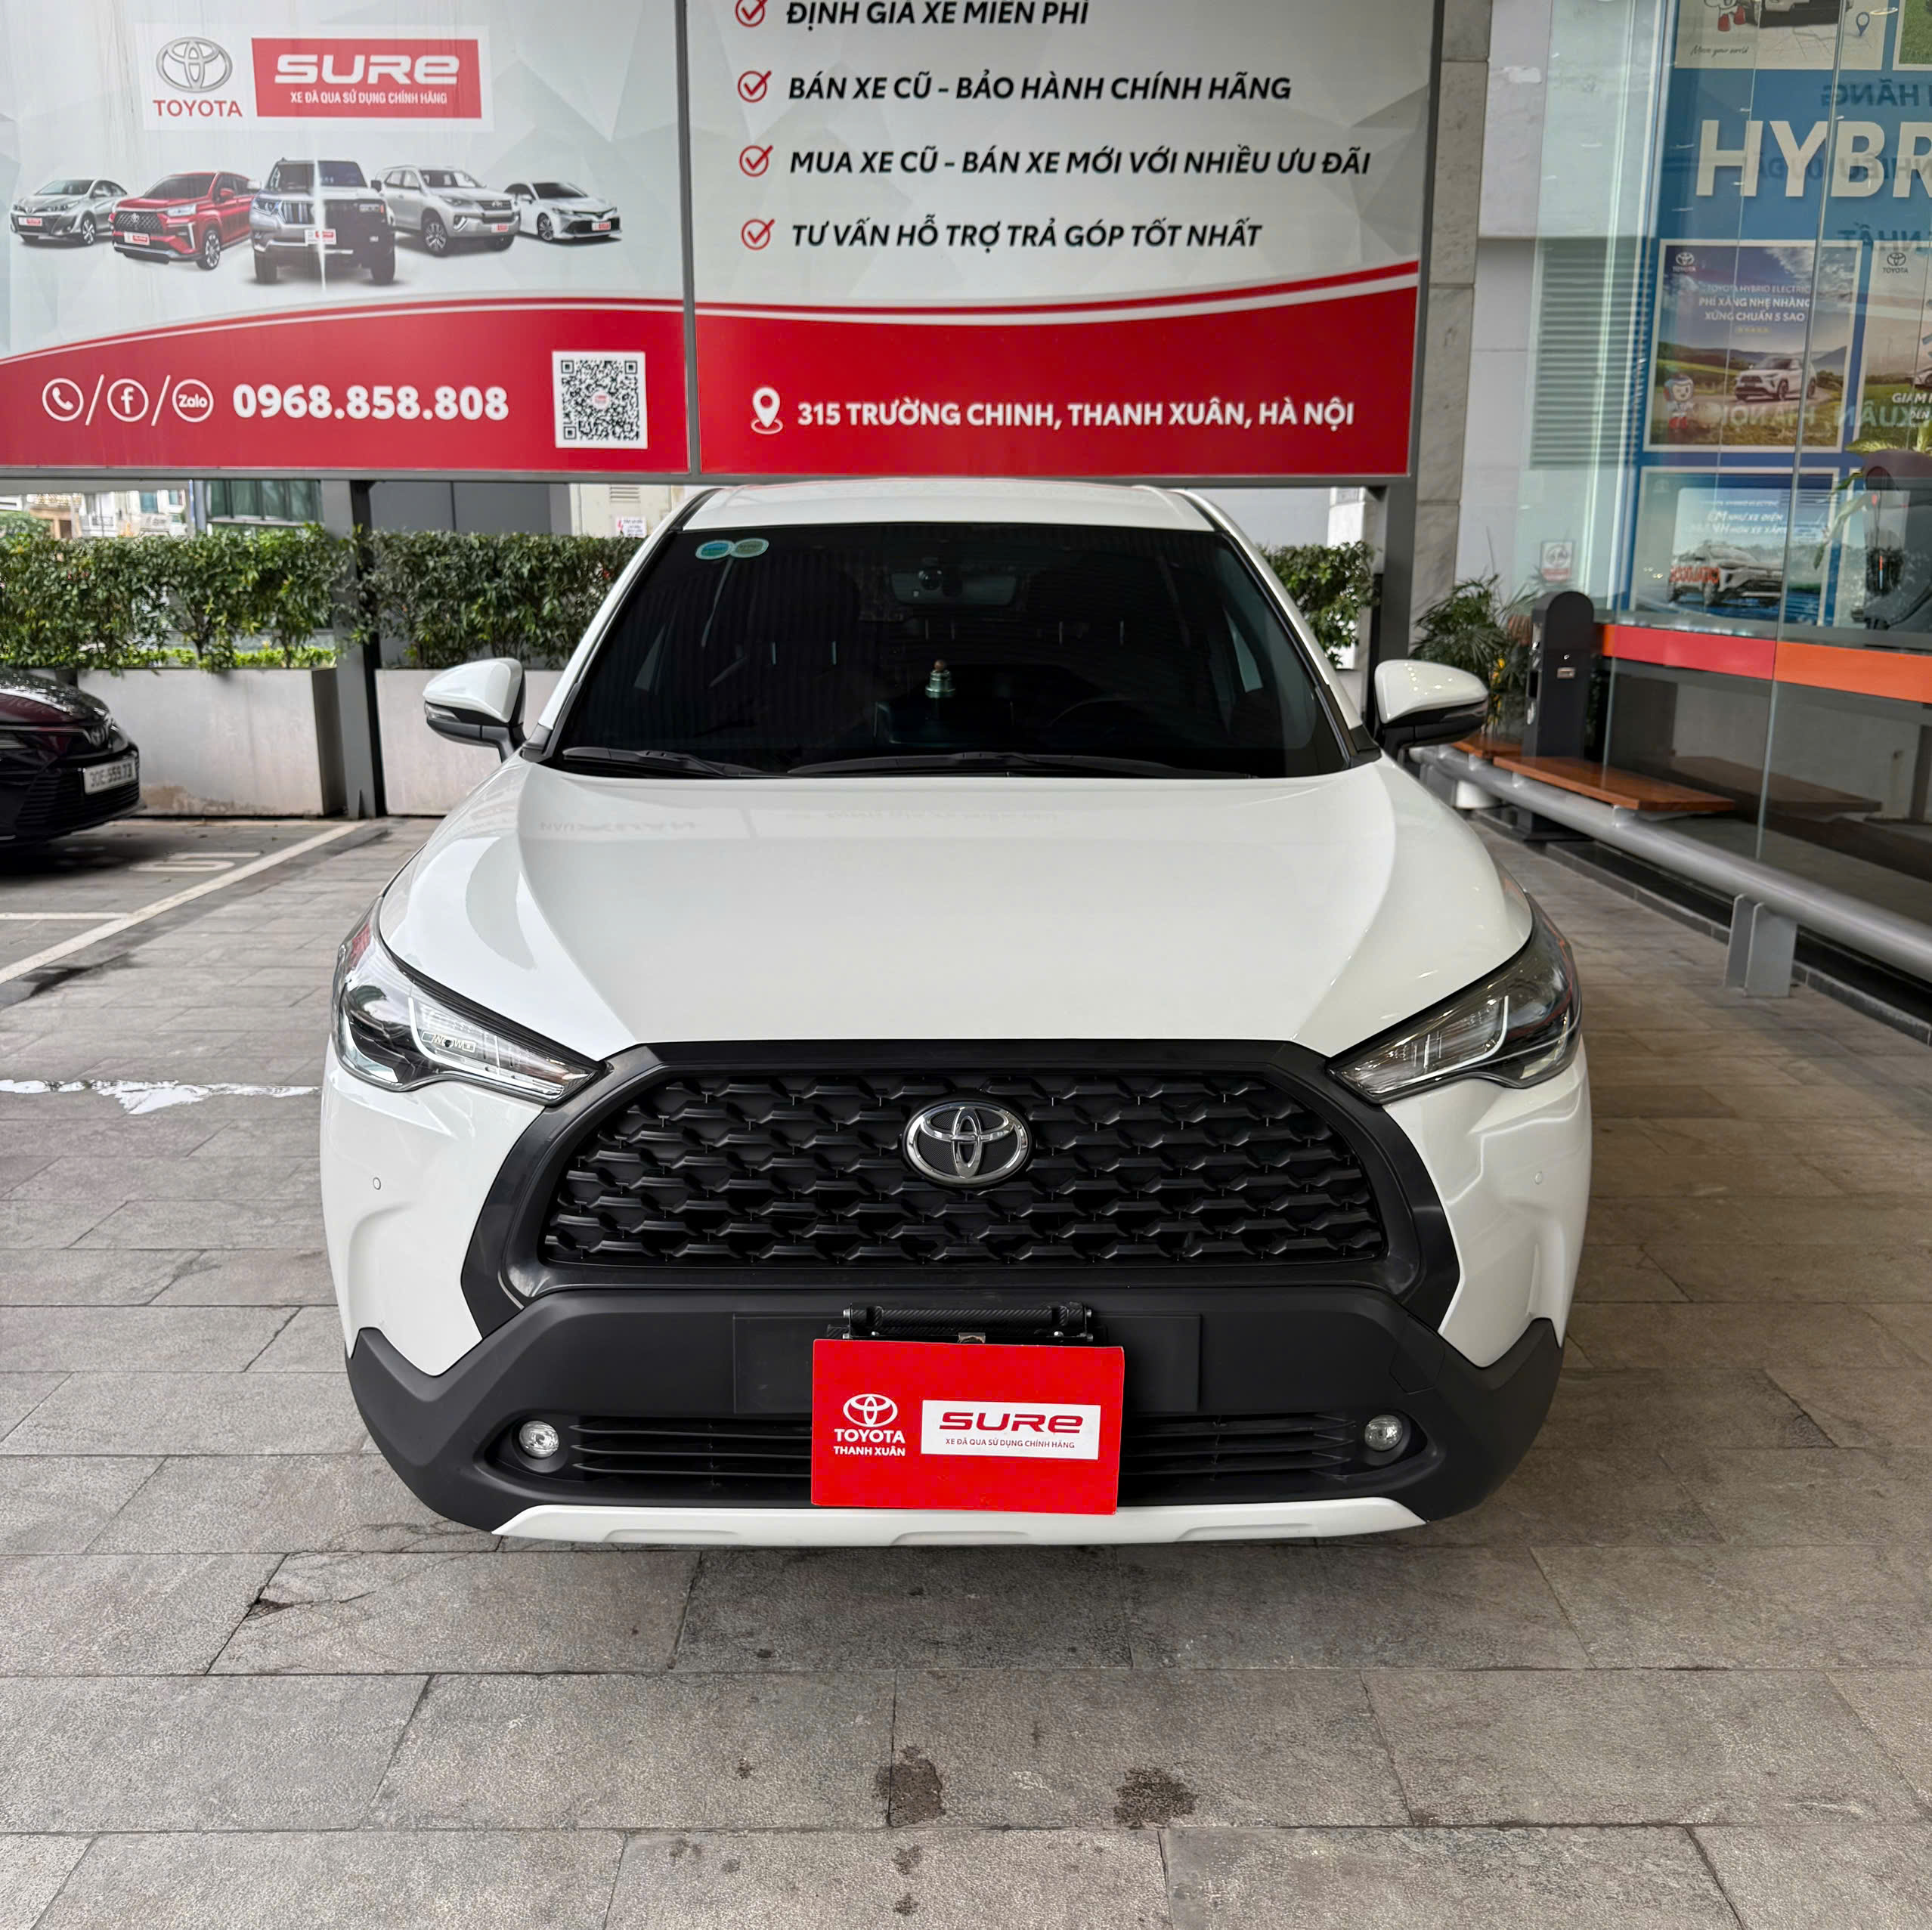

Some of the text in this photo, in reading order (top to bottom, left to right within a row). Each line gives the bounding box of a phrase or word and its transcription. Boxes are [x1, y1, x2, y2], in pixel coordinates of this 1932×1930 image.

[786, 2, 859, 31] ĐỊNH
[922, 2, 957, 24] XE
[788, 71, 847, 99] BÁN
[853, 77, 887, 99] XE
[893, 72, 932, 99] CŨ
[956, 70, 1014, 99] BẢO
[1020, 72, 1104, 100] HÀNH
[1111, 72, 1201, 100] CHÍNH
[1208, 73, 1292, 100] HÃNG
[290, 91, 302, 103] XE
[320, 91, 341, 104] QUA
[358, 91, 386, 105] DỤNG
[153, 100, 242, 117] TOYOTA
[790, 152, 853, 173] MUA
[859, 152, 894, 173] XE
[900, 146, 938, 174] CŨ
[961, 145, 1020, 174] BÁN
[1026, 152, 1060, 173] XE
[1066, 146, 1122, 174] MỚI
[1129, 146, 1178, 174] VỚI
[1184, 144, 1270, 174] NHIỀU
[1277, 149, 1316, 174] ƯU
[1322, 147, 1370, 174] ĐÃI
[792, 214, 1262, 253] TƯ VẤN HỖ TRỢ TRẢ GÓP TỐT NHẤT
[1740, 285, 1770, 293] HYBRID
[1772, 285, 1811, 294] ELECTRIC
[1783, 312, 1806, 322] SAO
[178, 392, 208, 409] Zalo
[232, 383, 509, 420] 0968.858.808
[797, 396, 1355, 432] 315 TRƯỜNG CHINH, THANH XUÂN, HÀ NỘI
[834, 1428, 906, 1444] TOYOTA
[988, 1437, 999, 1446] SỬ
[1000, 1439, 1023, 1449] DỤNG
[1025, 1438, 1050, 1448] CHÍNH
[1051, 1439, 1075, 1449] HÃNG
[834, 1445, 906, 1457] THANH XUÂN
